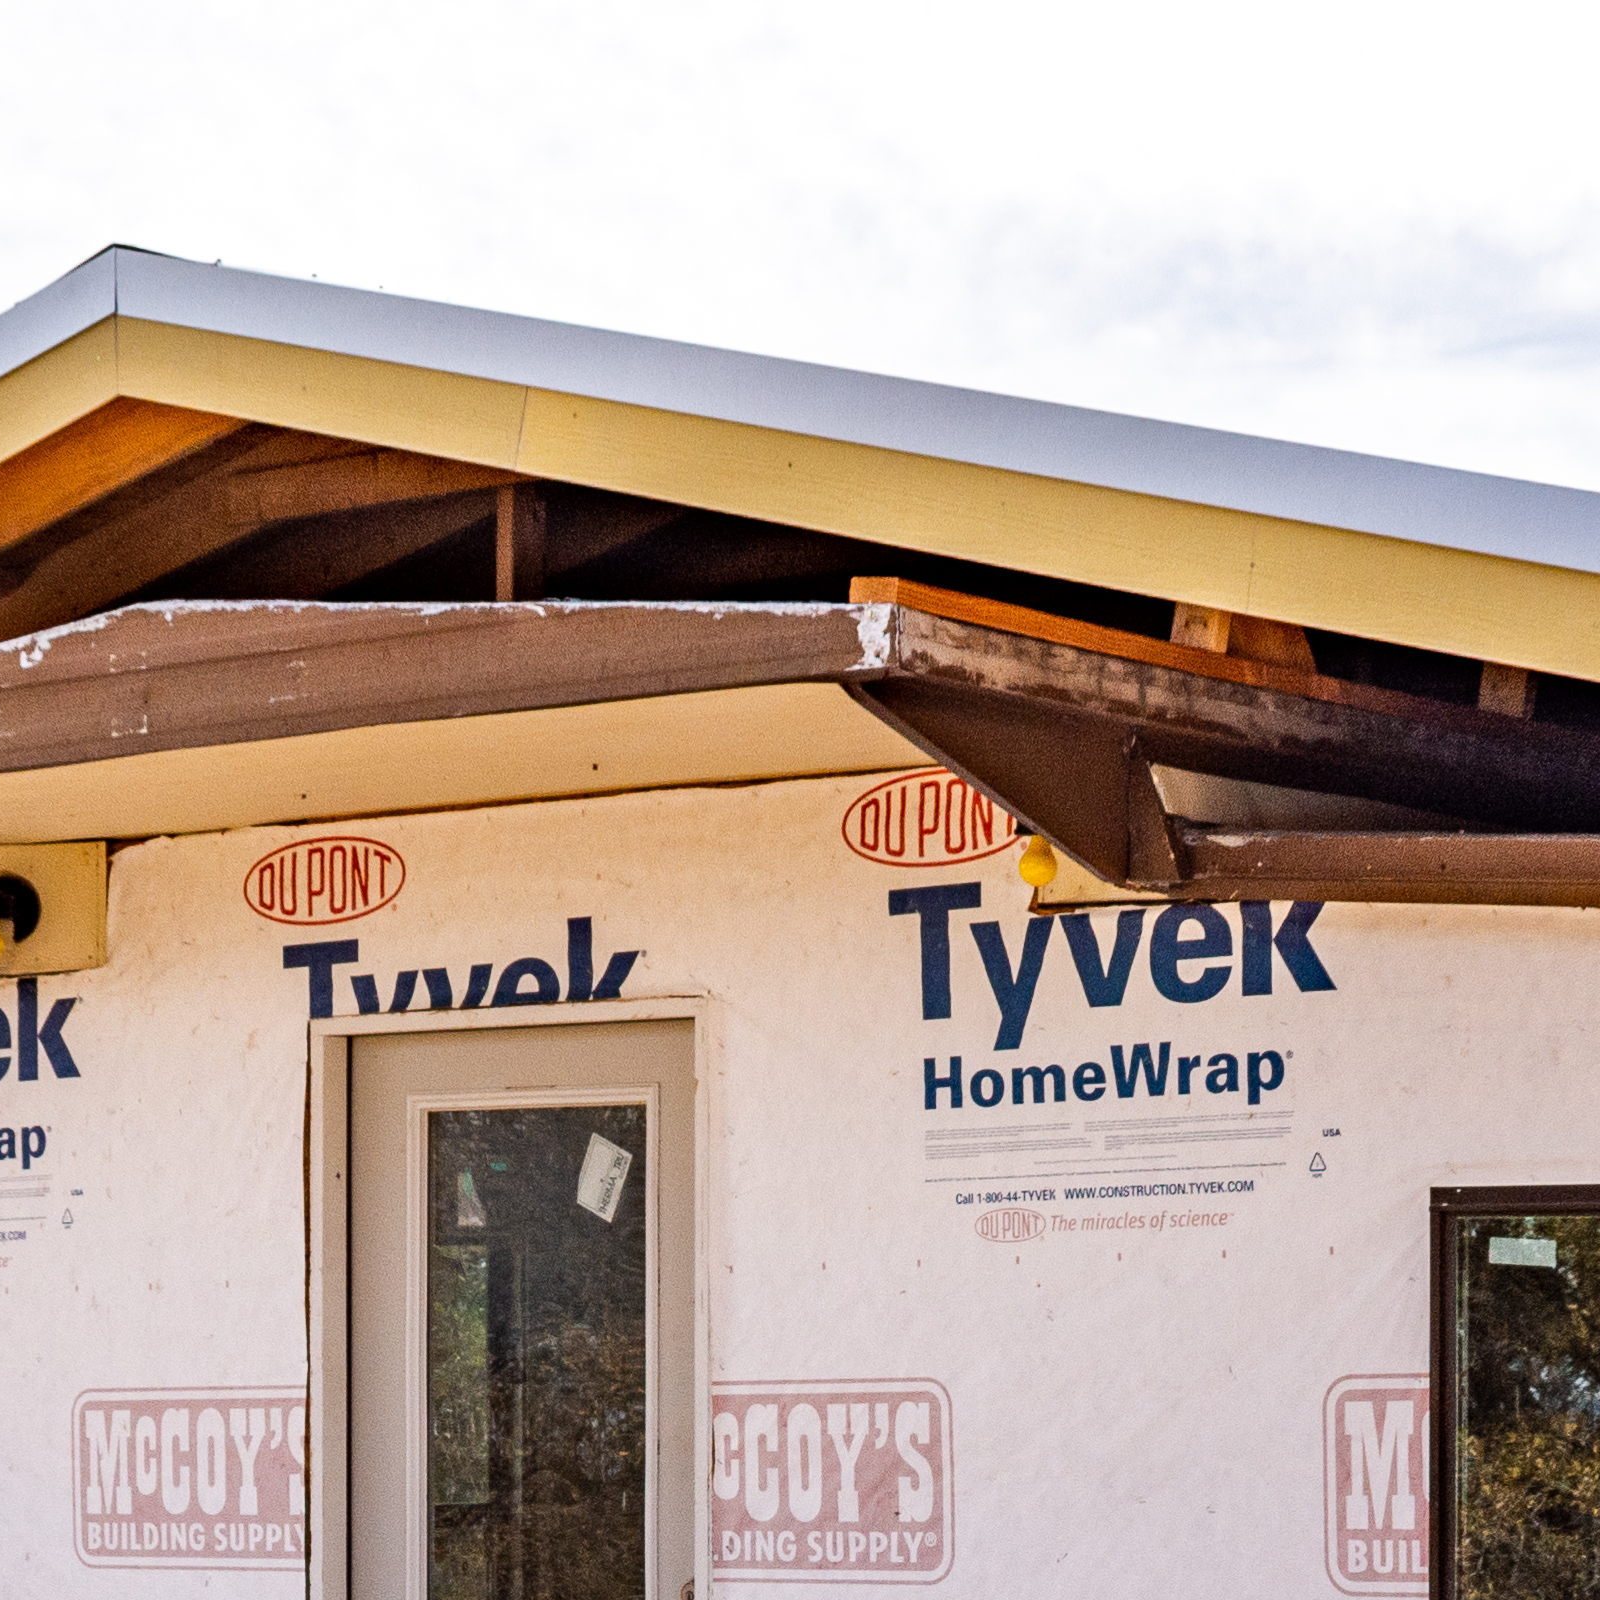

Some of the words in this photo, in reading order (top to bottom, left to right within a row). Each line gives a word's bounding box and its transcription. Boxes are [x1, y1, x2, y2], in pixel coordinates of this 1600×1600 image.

[923, 1042, 1286, 1110] HomeWrap
[1322, 1128, 1342, 1138] USA
[956, 1192, 974, 1205] Call
[977, 1188, 1056, 1205] 1-800-44-TYVEK
[1064, 1180, 1255, 1200] WWW.CONSTRUCTION.TYVEK.COM
[1050, 1214, 1077, 1232] The
[1080, 1211, 1146, 1231] miracles
[1150, 1210, 1169, 1232] of
[1170, 1209, 1229, 1228] science
[87, 1522, 206, 1551] BUILDING
[713, 1530, 798, 1562] DING
[806, 1530, 925, 1564] SUPPLY
